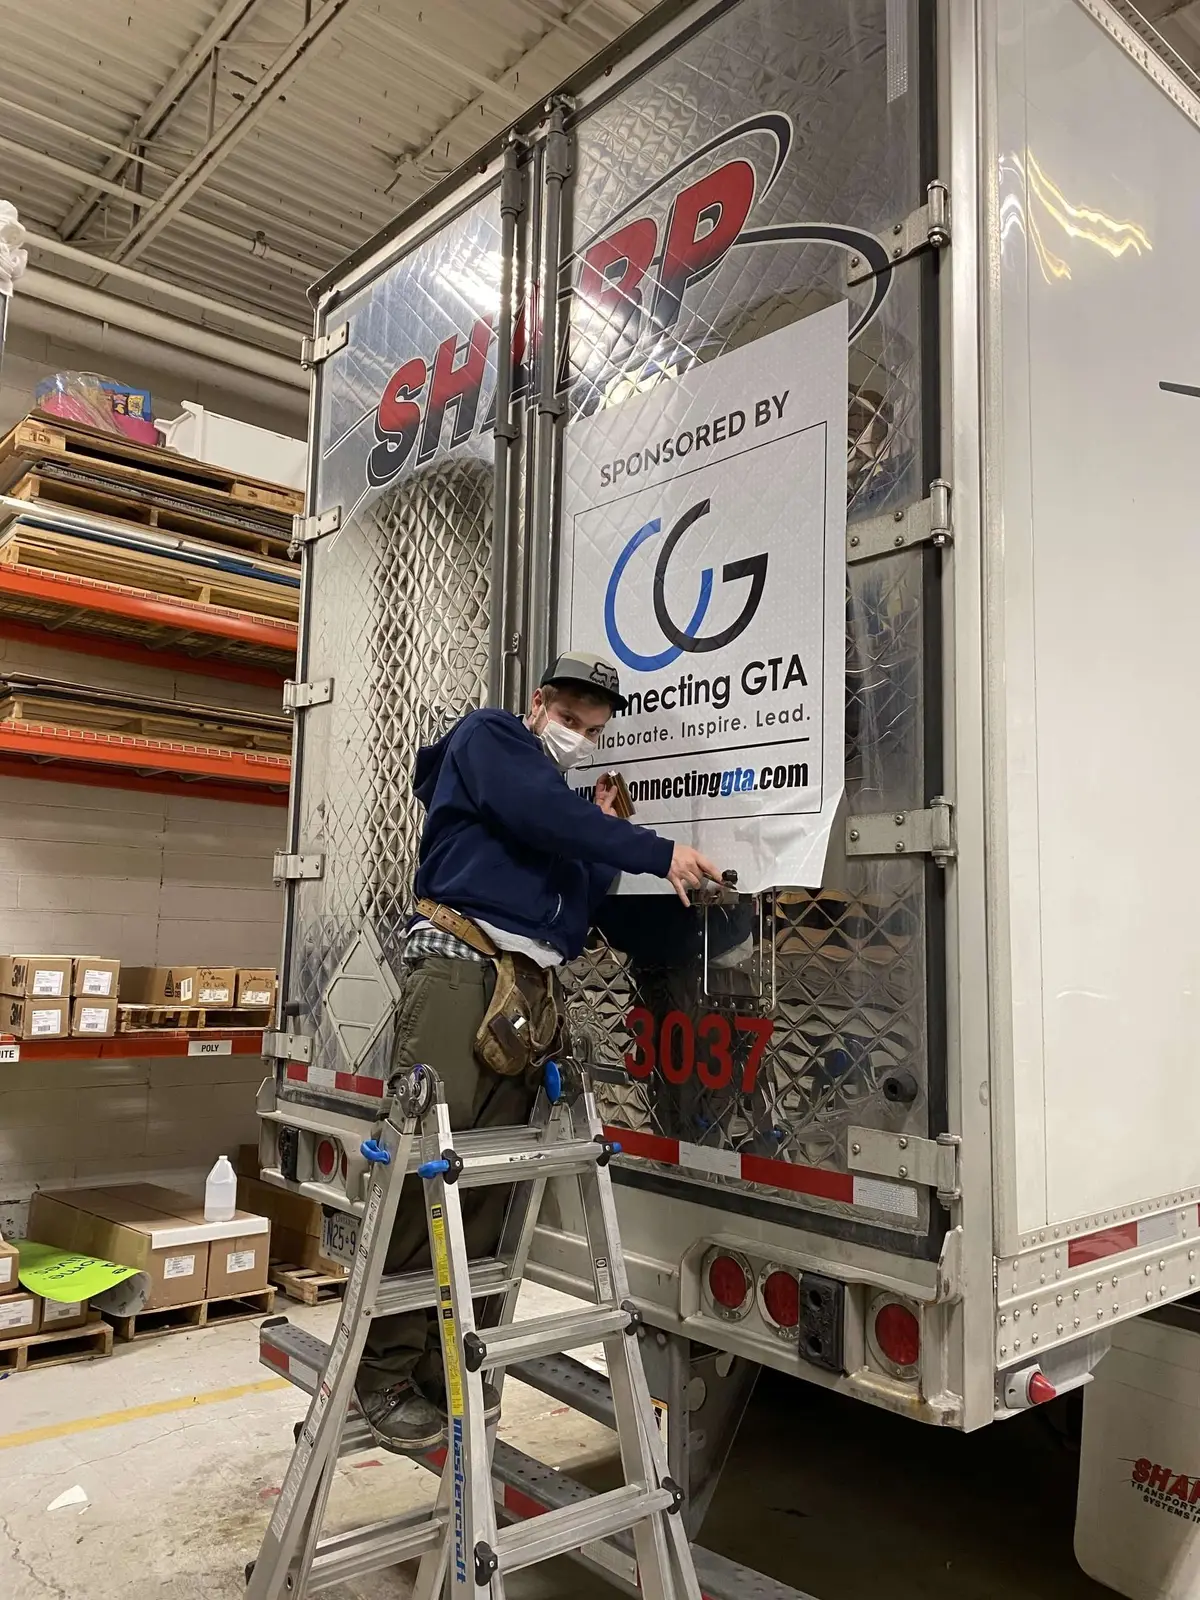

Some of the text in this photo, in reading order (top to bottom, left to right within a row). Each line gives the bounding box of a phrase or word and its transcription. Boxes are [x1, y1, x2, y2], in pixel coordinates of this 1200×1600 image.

[600, 390, 790, 488] SPONSORED BY
[613, 653, 808, 718] necting GTA
[597, 703, 812, 750] llaborate. Inspire. Lead.
[0, 1049, 15, 1059] ITE
[201, 1044, 220, 1053] POLY
[625, 1006, 774, 1094] 3037
[43, 1259, 97, 1281] ome.
[453, 1418, 466, 1584] Mastercraft
[1143, 1494, 1190, 1520] SYSTEMS
